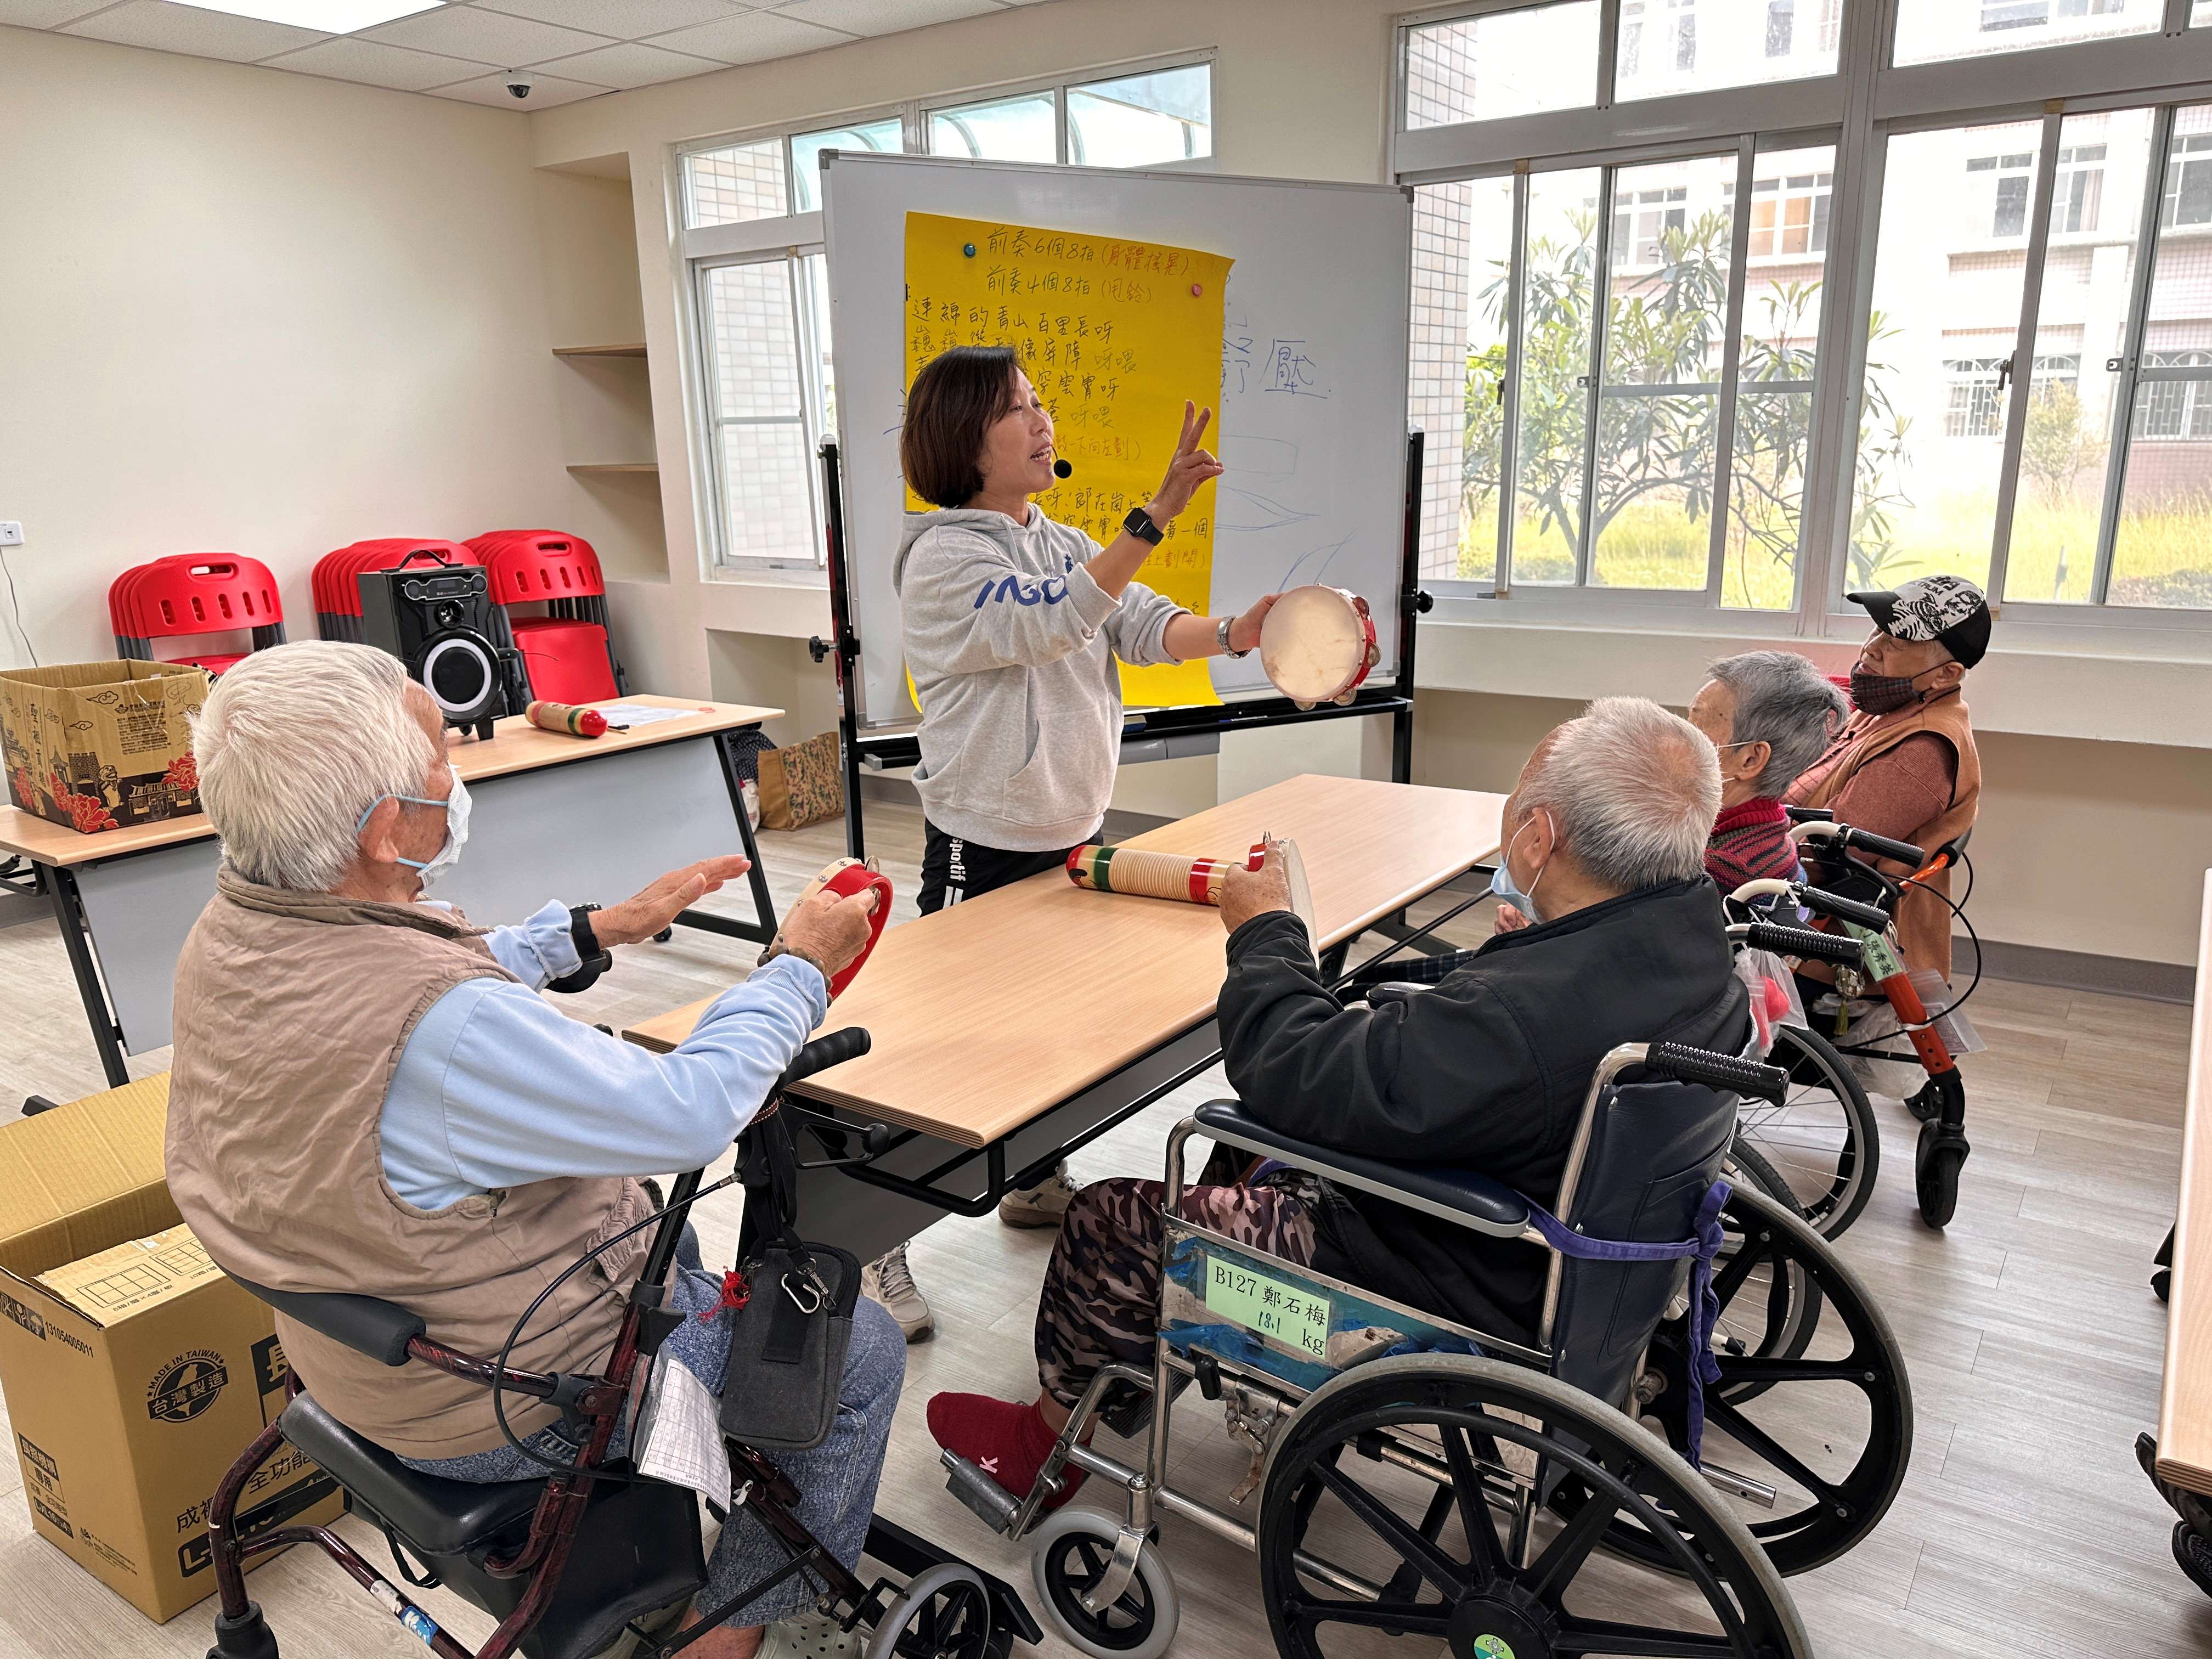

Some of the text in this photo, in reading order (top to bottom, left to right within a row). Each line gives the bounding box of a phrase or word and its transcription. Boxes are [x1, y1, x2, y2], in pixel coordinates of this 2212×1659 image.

[1215, 1266, 1327, 1327] B127 鄭石梅
[45, 1321, 94, 1358] 131054005011
[1302, 1328, 1324, 1356] kg
[148, 1349, 221, 1389] MADE IN TAIWAN
[152, 1372, 224, 1414] 台灣製造
